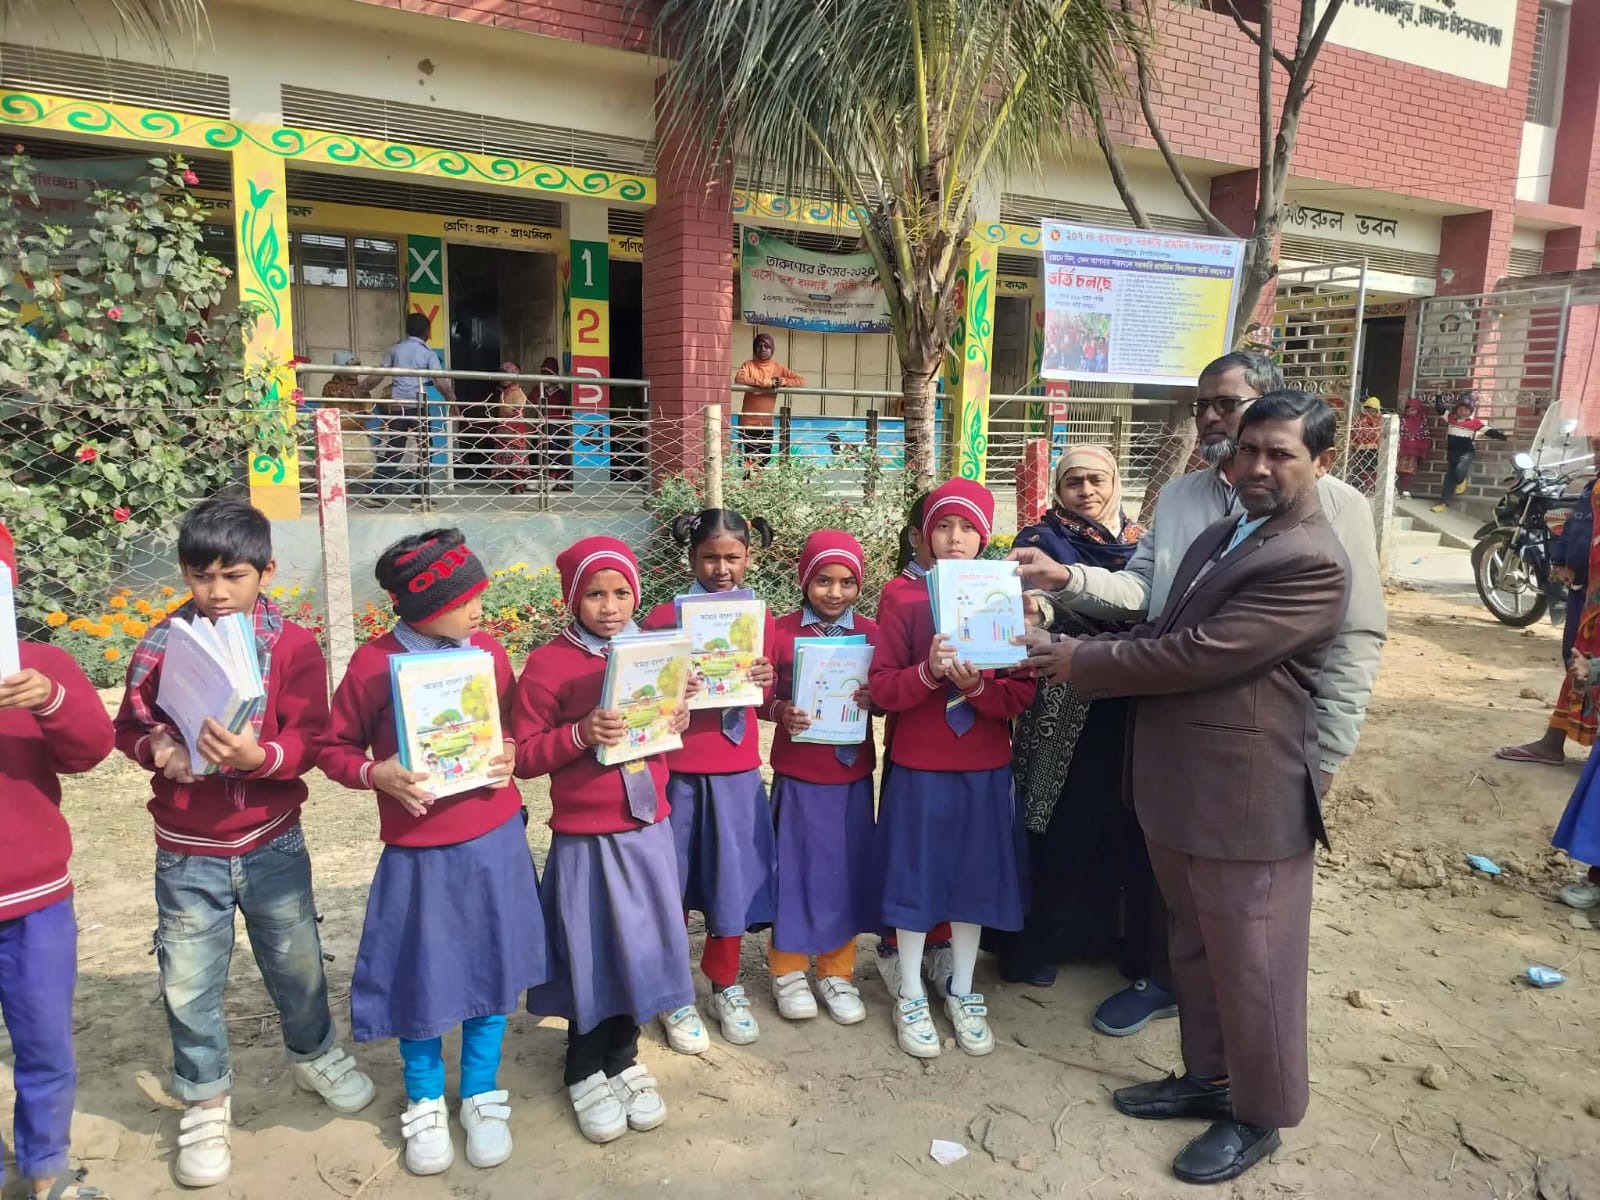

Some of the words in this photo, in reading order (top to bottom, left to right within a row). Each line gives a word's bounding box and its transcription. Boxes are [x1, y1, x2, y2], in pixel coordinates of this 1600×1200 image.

[510, 227, 552, 241] প্রাথমিক
[1355, 214, 1398, 238] ভবন
[408, 247, 441, 285] X
[580, 248, 594, 286] 1
[766, 255, 816, 275] তারুণ্যের
[1048, 267, 1075, 286] ভর্তি
[1076, 274, 1112, 292] চলছে
[577, 309, 600, 343] 2
[577, 366, 603, 404] 3
